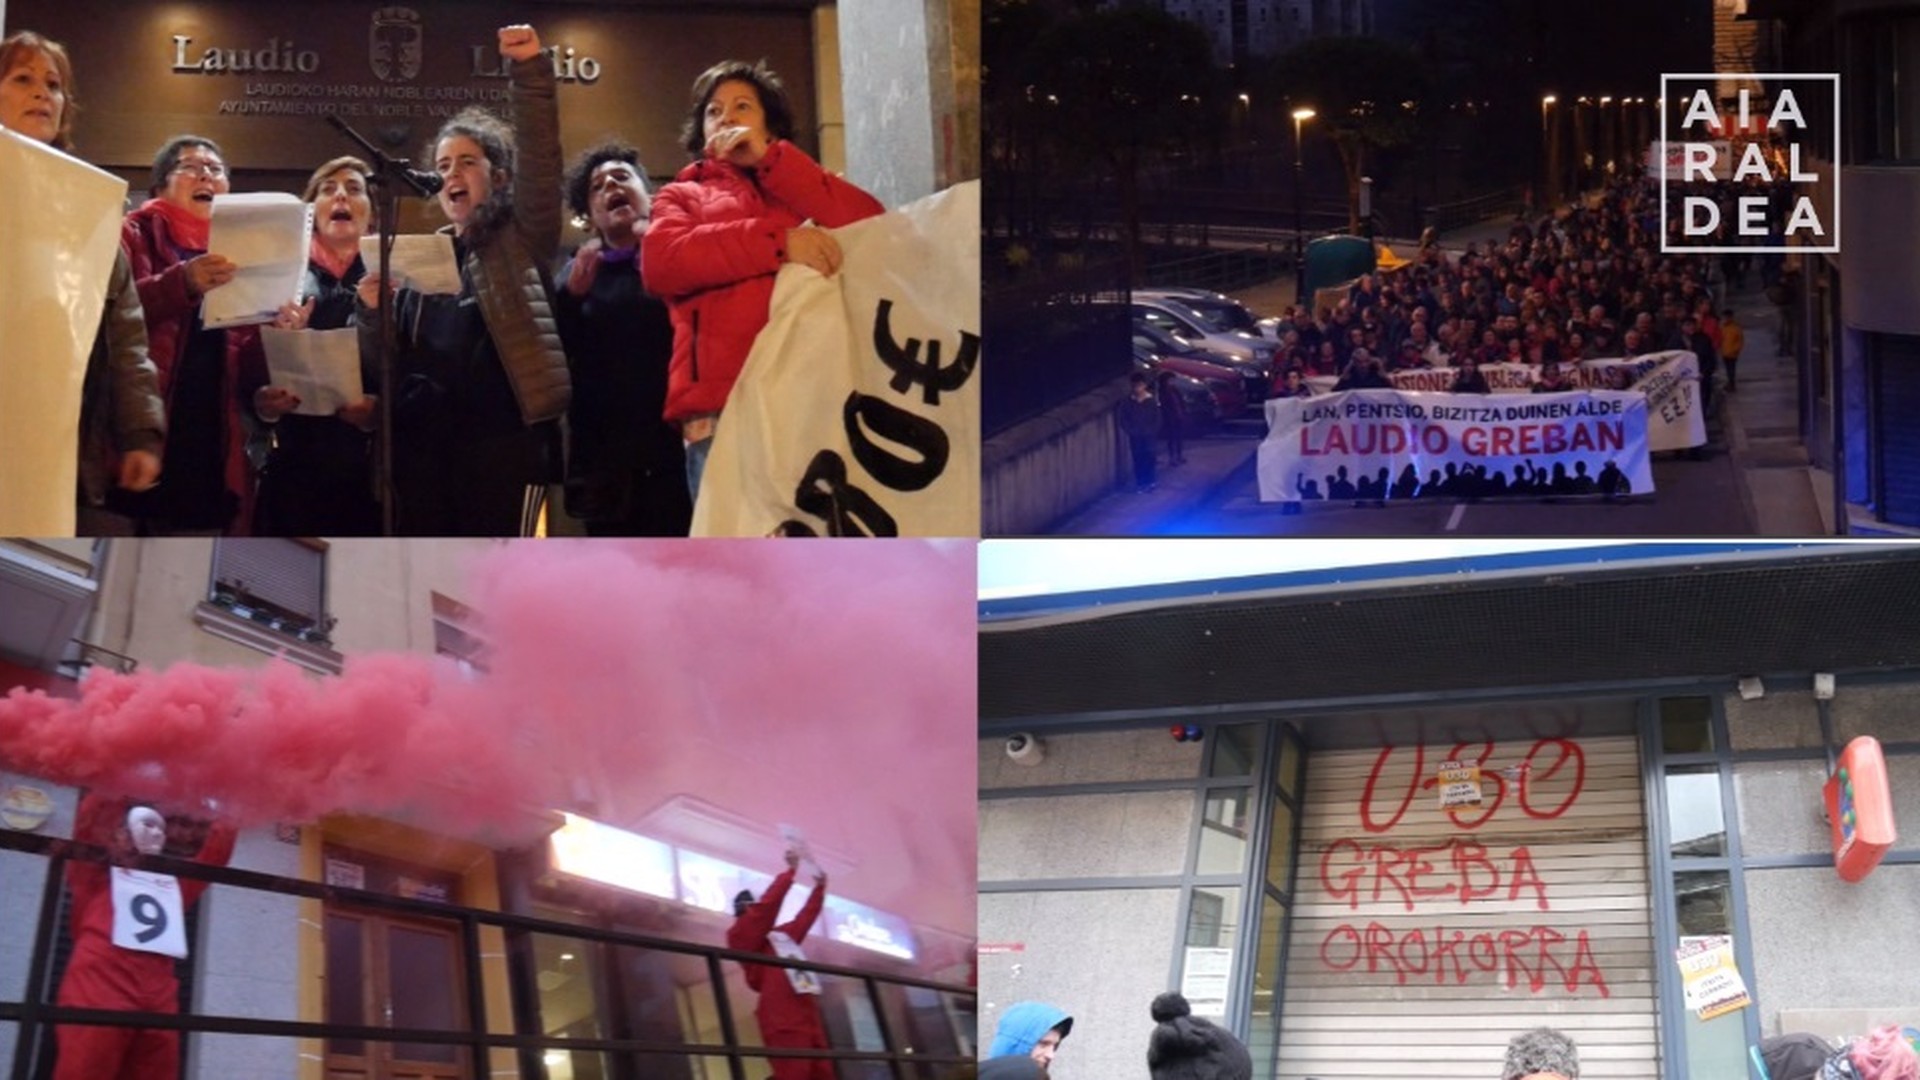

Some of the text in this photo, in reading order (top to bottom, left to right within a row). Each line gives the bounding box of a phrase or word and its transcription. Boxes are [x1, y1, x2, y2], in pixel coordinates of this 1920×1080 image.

[172, 34, 320, 73] Laudio
[218, 100, 336, 115] AYUNTAMIENTO
[341, 103, 371, 116] DEL
[376, 104, 423, 117] NOBLE
[245, 82, 323, 96] LAUDIOKO
[327, 85, 379, 98] HARAN
[383, 86, 475, 100] NOBLEAREN
[1302, 400, 1622, 423] LAN, PENTSIO, BIZITZA DUINEN ALDE
[1300, 421, 1625, 457] LAUDIO GREBAN
[1320, 838, 1549, 911] GREBA
[130, 893, 168, 944] 9
[1320, 921, 1610, 999] OROKORRA
